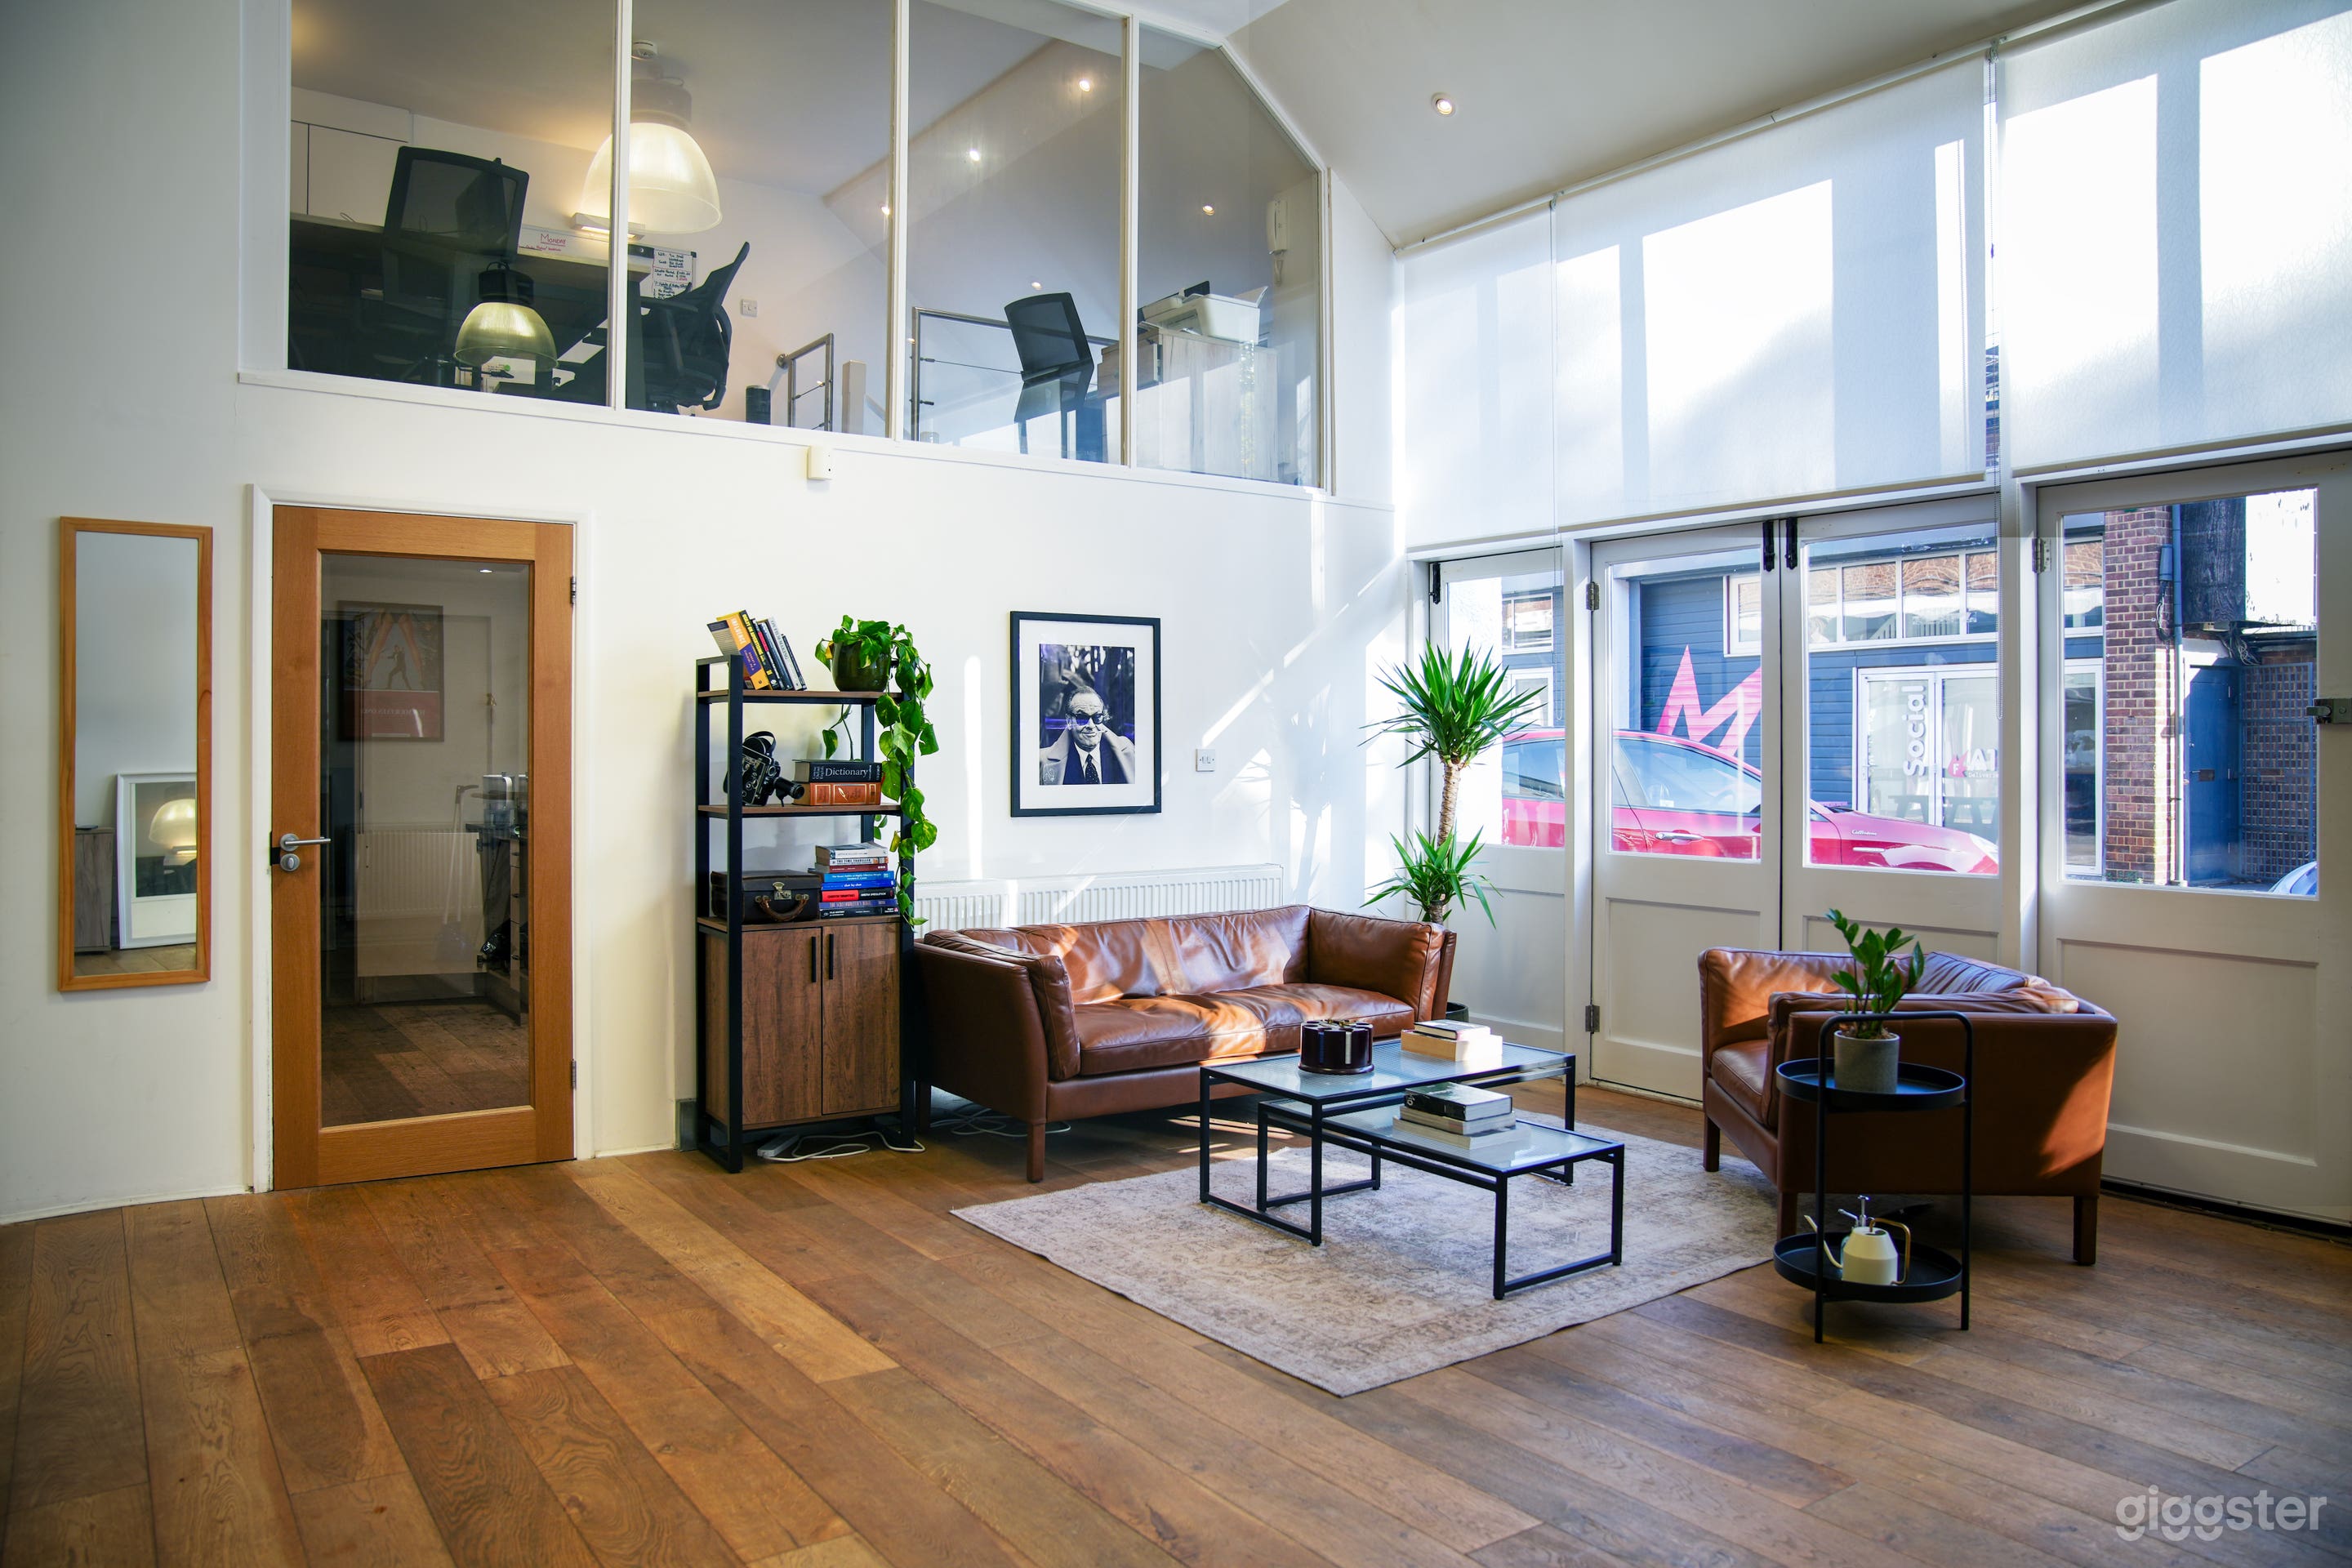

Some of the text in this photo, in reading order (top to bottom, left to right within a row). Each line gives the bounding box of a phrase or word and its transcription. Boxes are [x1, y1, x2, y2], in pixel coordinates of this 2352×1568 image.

[730, 617, 746, 644] INFLUENCE
[1901, 685, 1925, 776] Social
[825, 768, 868, 777] Dictionary
[1953, 763, 1959, 775] F
